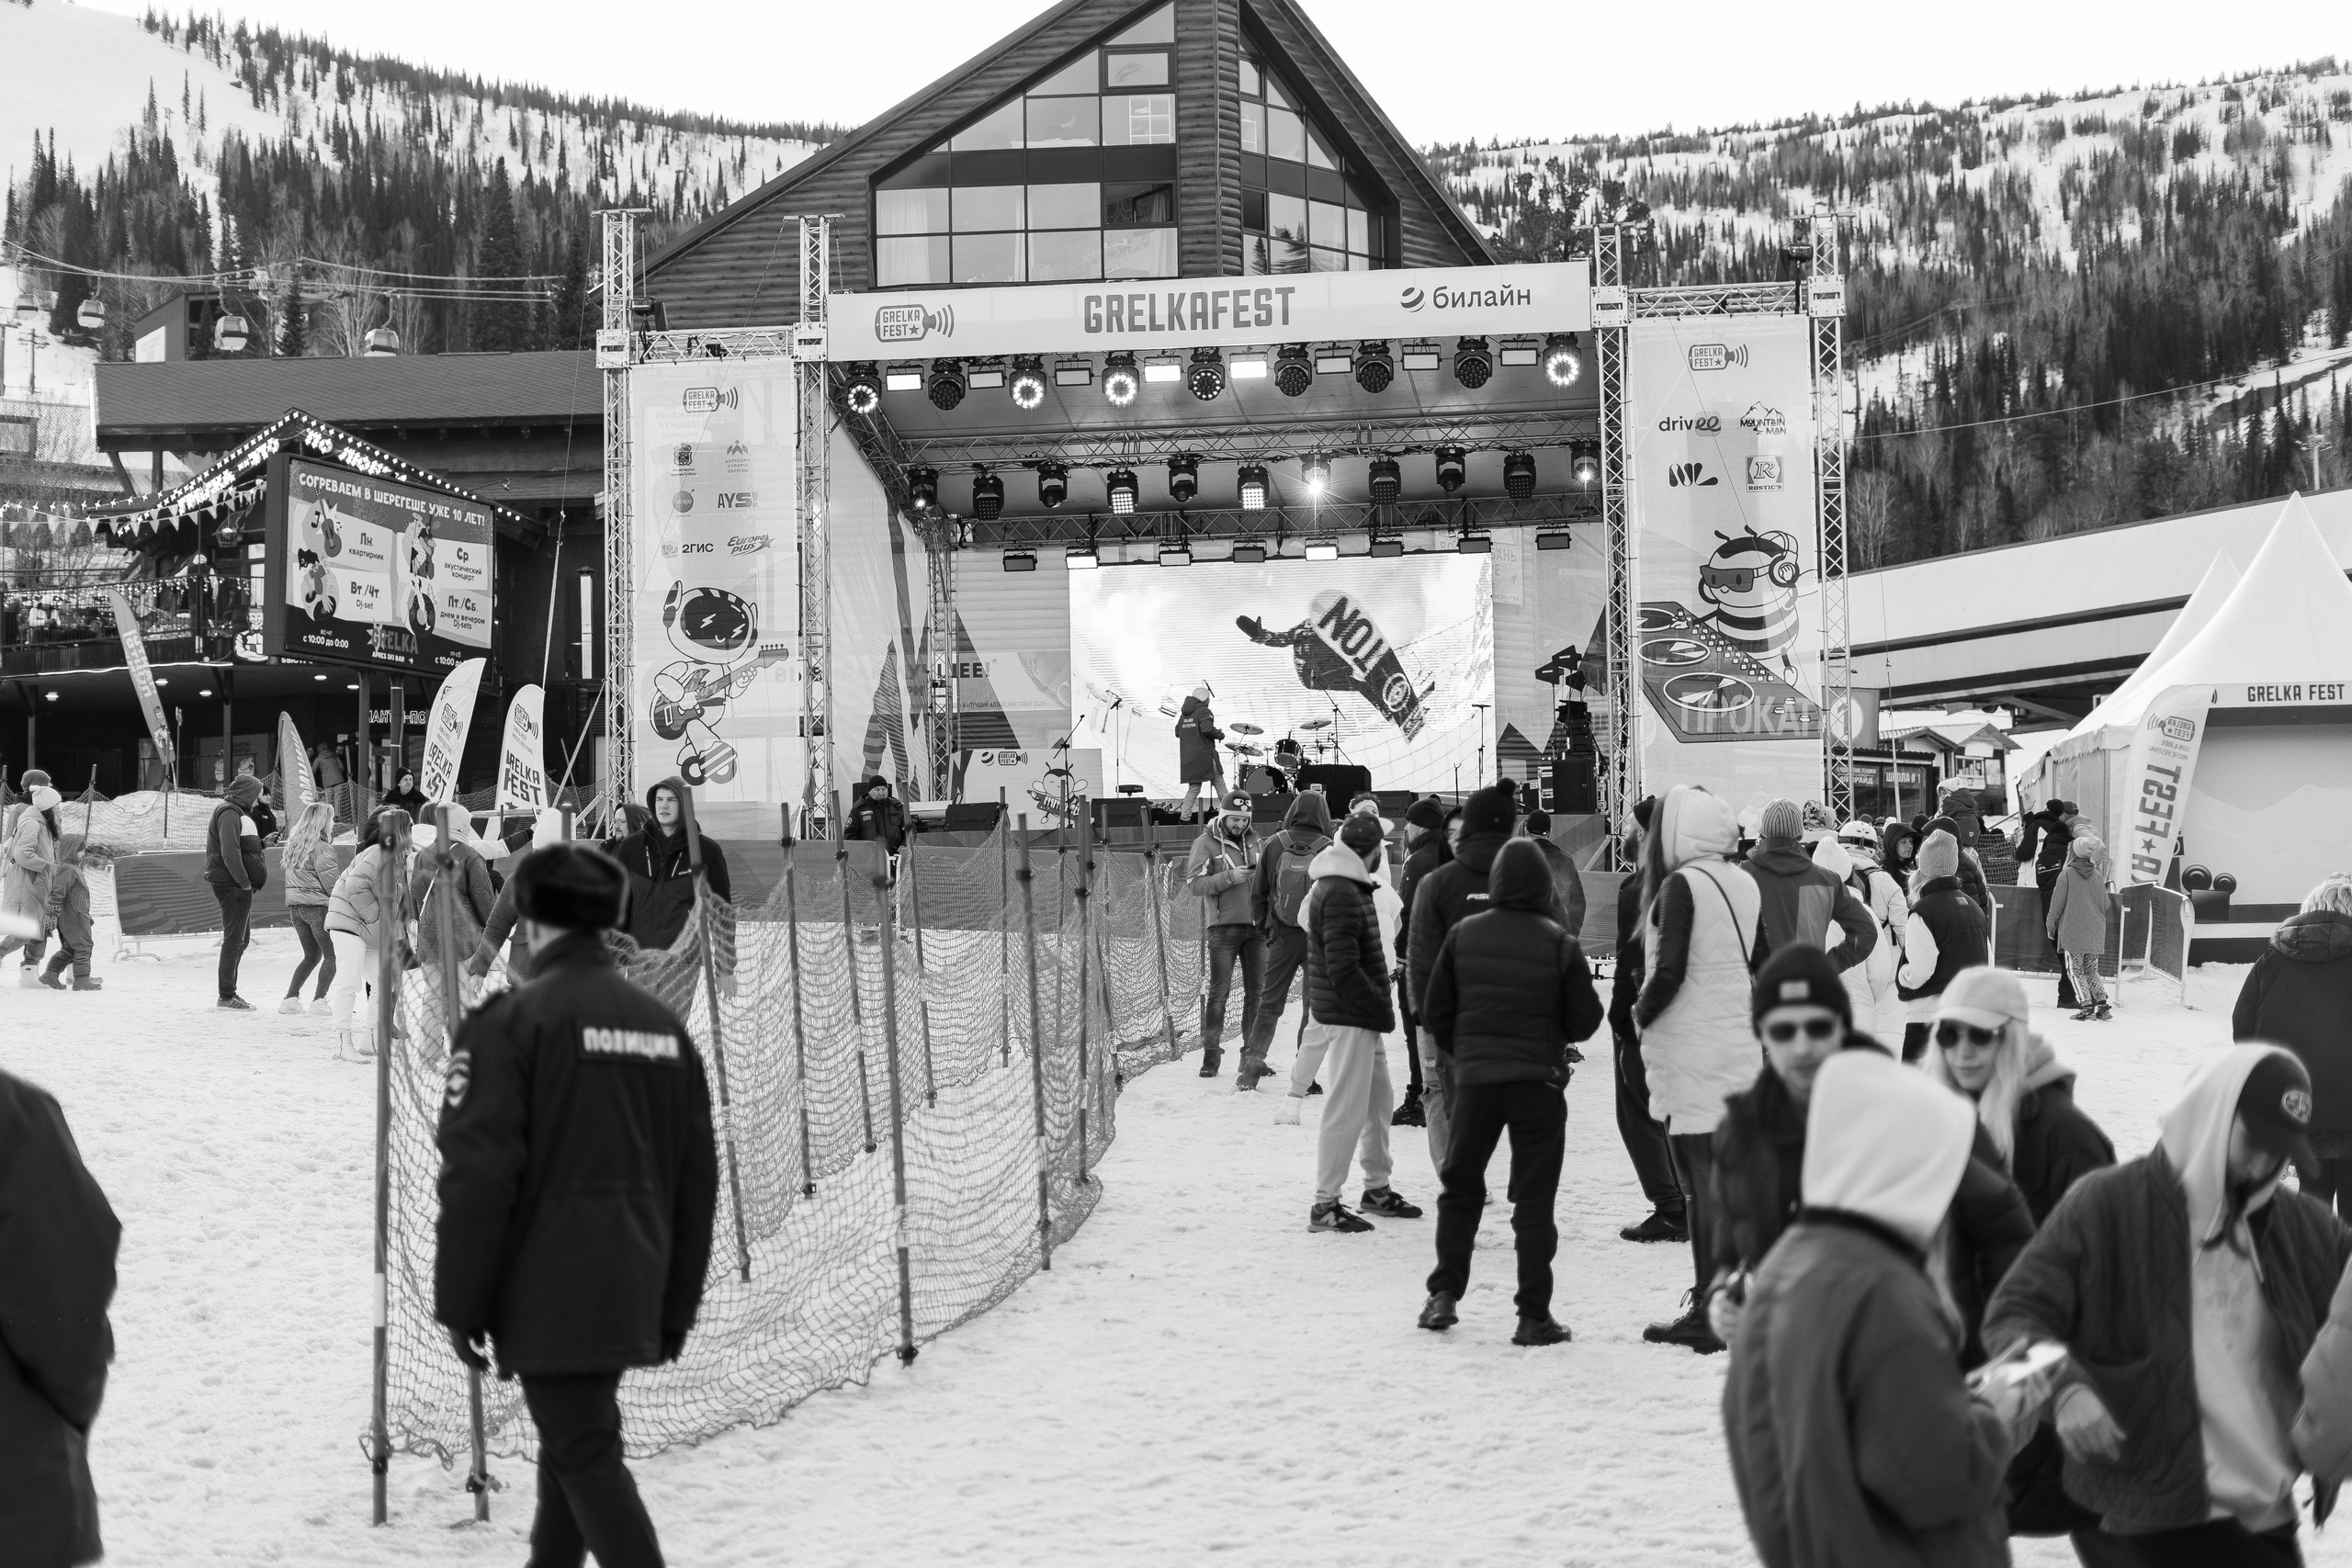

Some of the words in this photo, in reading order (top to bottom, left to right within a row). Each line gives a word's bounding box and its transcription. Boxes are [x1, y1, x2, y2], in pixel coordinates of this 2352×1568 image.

[1433, 284, 1531, 310] билайн
[883, 310, 921, 323] GRELKA
[1084, 287, 1295, 333] GRELKAFEST
[884, 324, 909, 337] FEST
[1694, 347, 1723, 357] GRELKA
[1694, 357, 1714, 367] FEST
[688, 390, 715, 400] GRELKA
[688, 400, 707, 409] FEST
[1658, 415, 1722, 432] drivee
[1739, 418, 1786, 428] MOUNTAIN
[1765, 427, 1787, 435] MAN
[299, 472, 362, 499] СОГРЕВАЕМ
[364, 487, 371, 500] В
[374, 490, 426, 513] ШЕРЕГЕШЕ
[428, 502, 450, 519] УЖЕ
[453, 508, 462, 521] 10
[464, 510, 485, 526] ЛЕТ!
[360, 533, 374, 547] Пн.
[348, 547, 385, 561] квартирник
[457, 547, 470, 563] Ср.
[682, 543, 714, 554] 2ГИС
[444, 562, 482, 577] акустический
[452, 571, 475, 582] концерт
[356, 599, 374, 611] Dj-set
[440, 611, 455, 622] днем
[460, 615, 486, 626] вечером
[453, 619, 472, 630] Dj-sets
[308, 635, 325, 645] 10:00
[325, 638, 334, 647] до
[334, 638, 349, 649] 0:00
[371, 628, 419, 655] GRELKA
[395, 654, 405, 663] BAR
[439, 657, 455, 666] 10:00
[2247, 684, 2301, 702] GRELKA
[2309, 683, 2346, 700] FEST
[1886, 772, 1910, 784] ШОЛА
